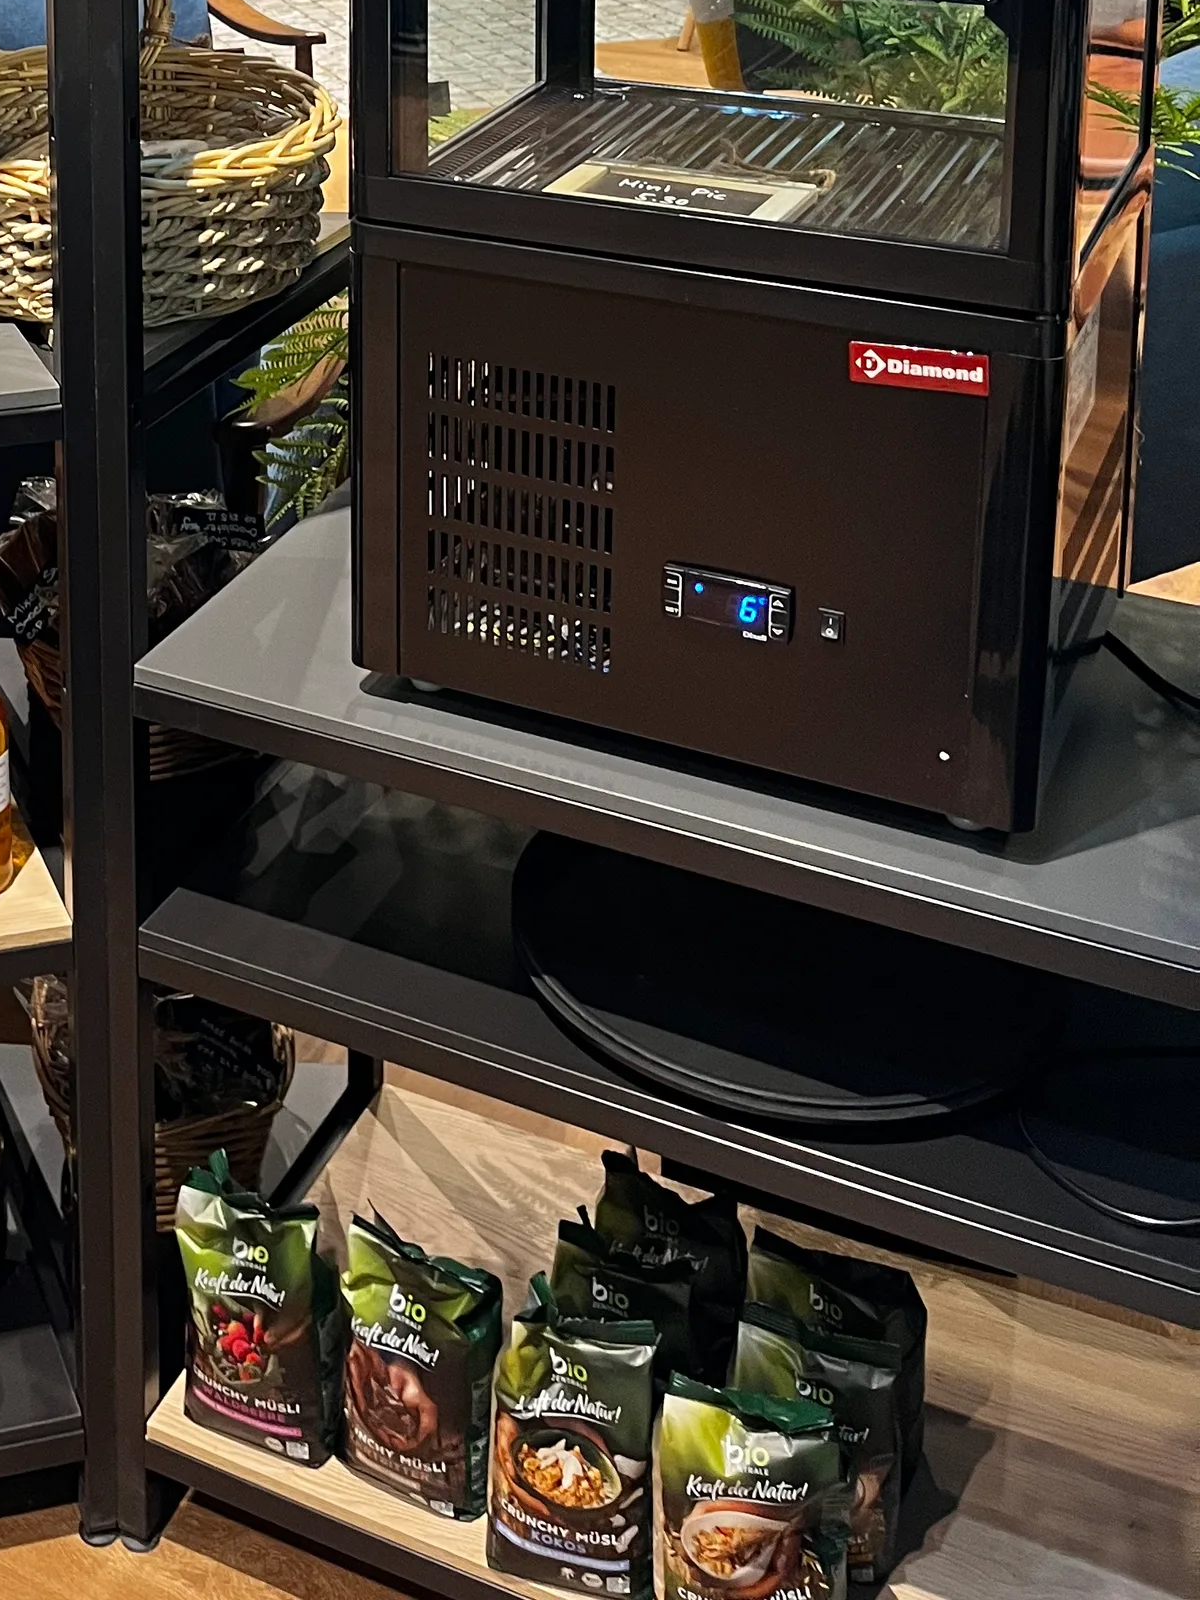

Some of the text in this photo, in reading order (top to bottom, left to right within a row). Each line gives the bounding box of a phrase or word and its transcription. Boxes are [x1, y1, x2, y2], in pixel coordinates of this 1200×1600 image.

[618, 177, 671, 193] Mini
[887, 358, 984, 383] Diamond
[194, 1267, 230, 1295] Kraft
[592, 1276, 629, 1310] bio
[389, 1283, 426, 1322] bio
[809, 1283, 843, 1321] bio
[549, 1346, 588, 1382] bio
[794, 1369, 834, 1405] bio
[255, 1397, 300, 1415] MÜSLI
[573, 1393, 622, 1424] Natur!
[399, 1454, 447, 1474] MÜSLI
[723, 1433, 771, 1467] bio
[685, 1473, 810, 1503] Kraft der Natur!
[501, 1498, 570, 1539] CRUNCHY
[531, 1528, 587, 1555] KOKOS
